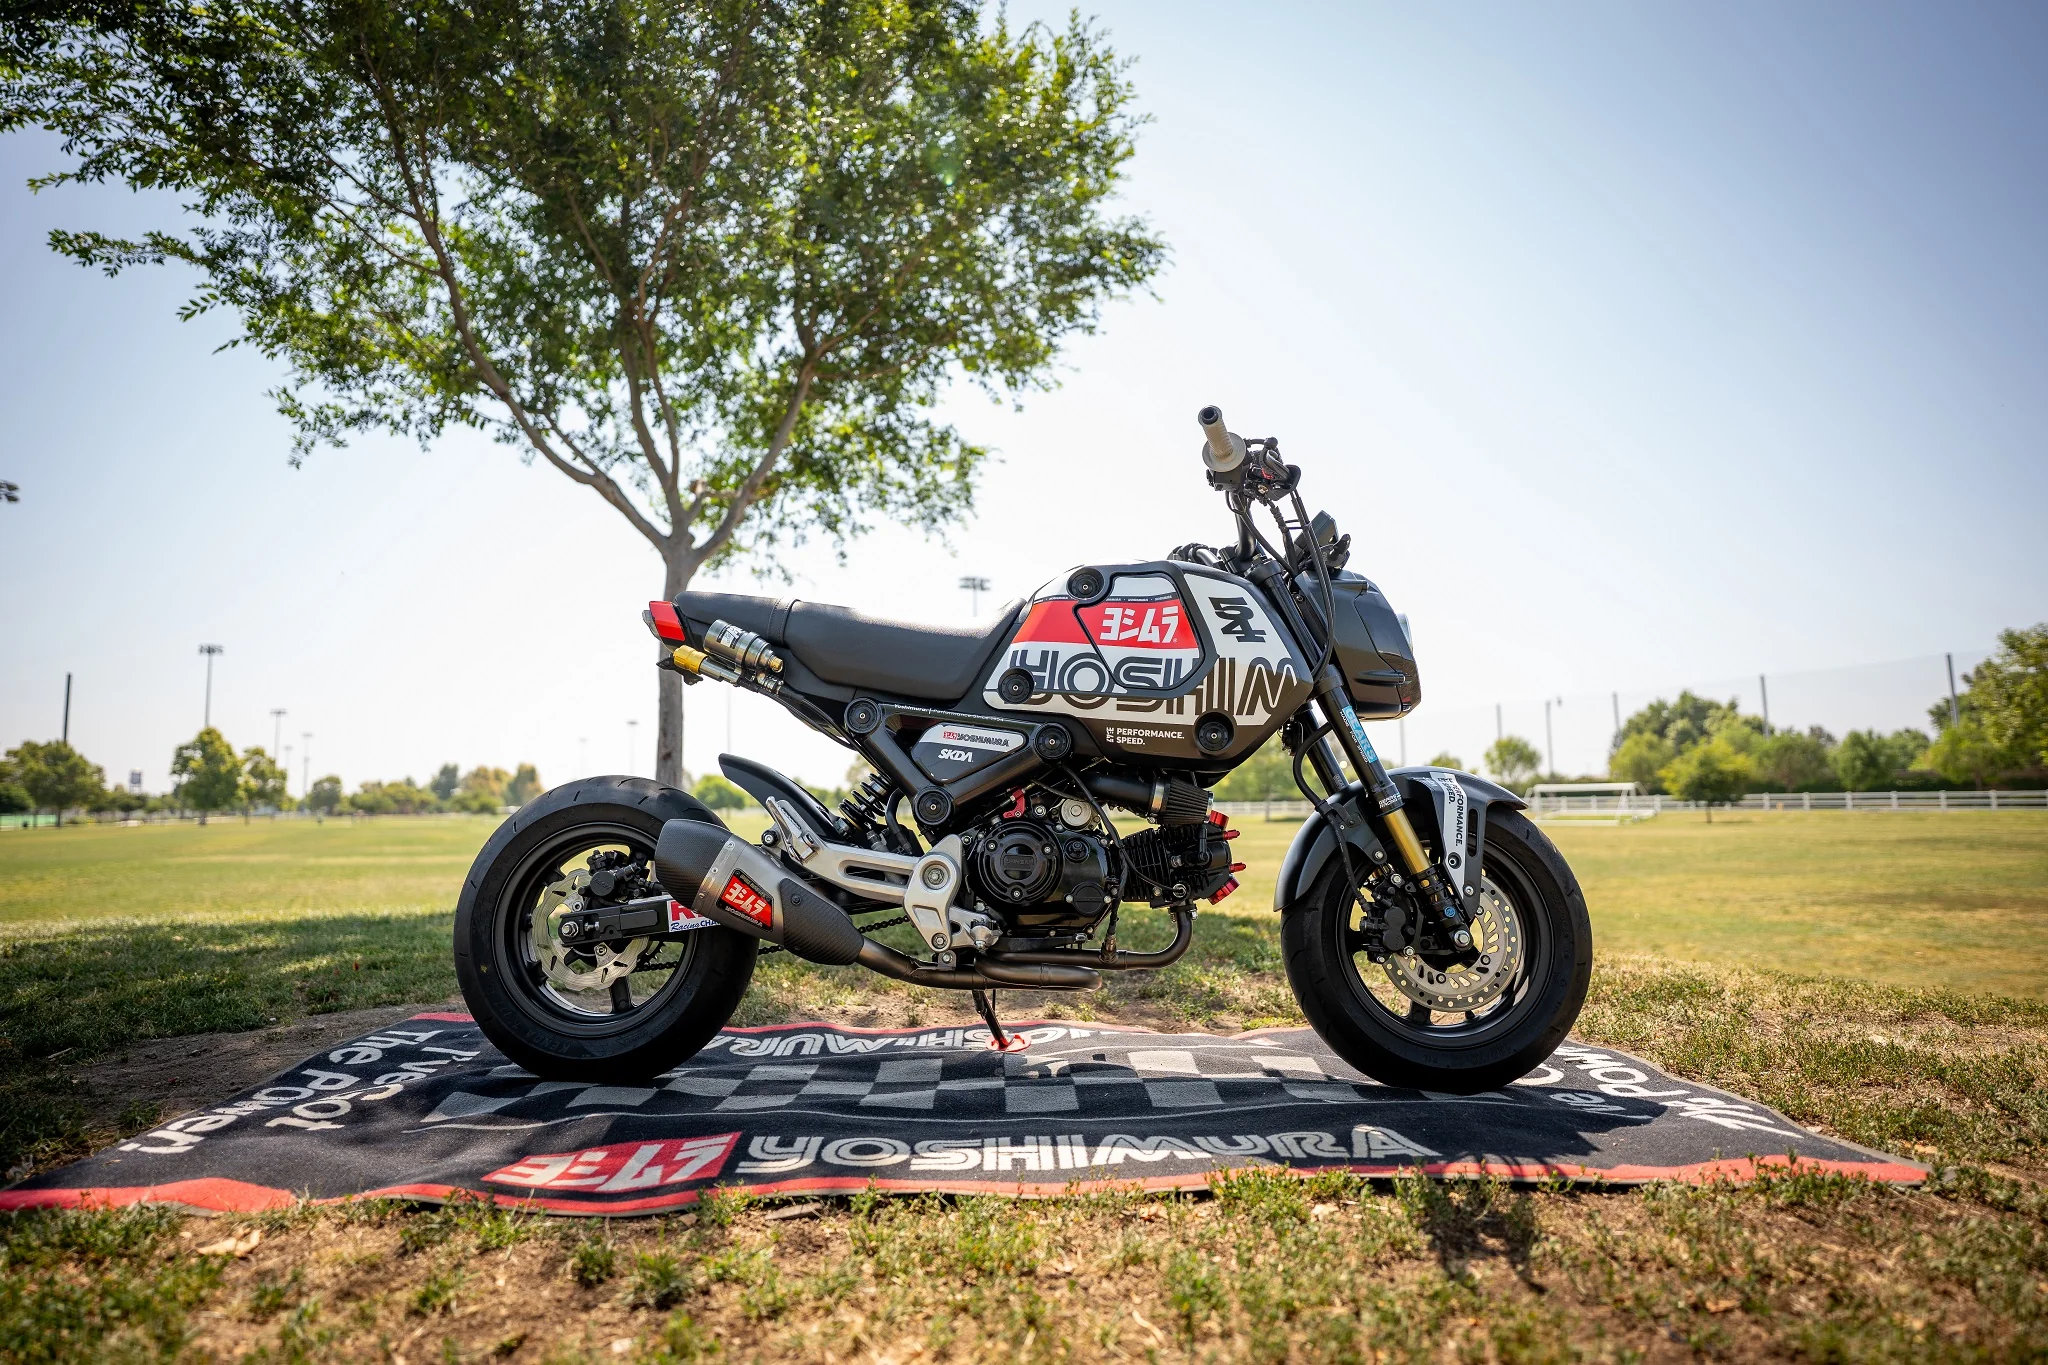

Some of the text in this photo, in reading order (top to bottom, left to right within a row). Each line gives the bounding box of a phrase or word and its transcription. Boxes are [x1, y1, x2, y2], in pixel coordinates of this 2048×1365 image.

[1100, 606, 1179, 643] ヨシムラ
[1209, 597, 1266, 643] 54
[957, 733, 1010, 747] YOSHIMURA
[1116, 728, 1185, 740] PERFORMANCE.
[1116, 736, 1146, 746] SPEED.
[1345, 708, 1377, 761] GEARS
[938, 748, 973, 763] SKDA
[1452, 784, 1464, 847] PERFORMANCE.
[671, 901, 703, 921] R
[725, 882, 767, 916] ヨシムラ
[118, 1029, 444, 1155] The Power!
[1553, 1046, 1690, 1097] Pow
[491, 1134, 733, 1192] ヨシムラ
[735, 1123, 1443, 1173] YOSHIMURA
